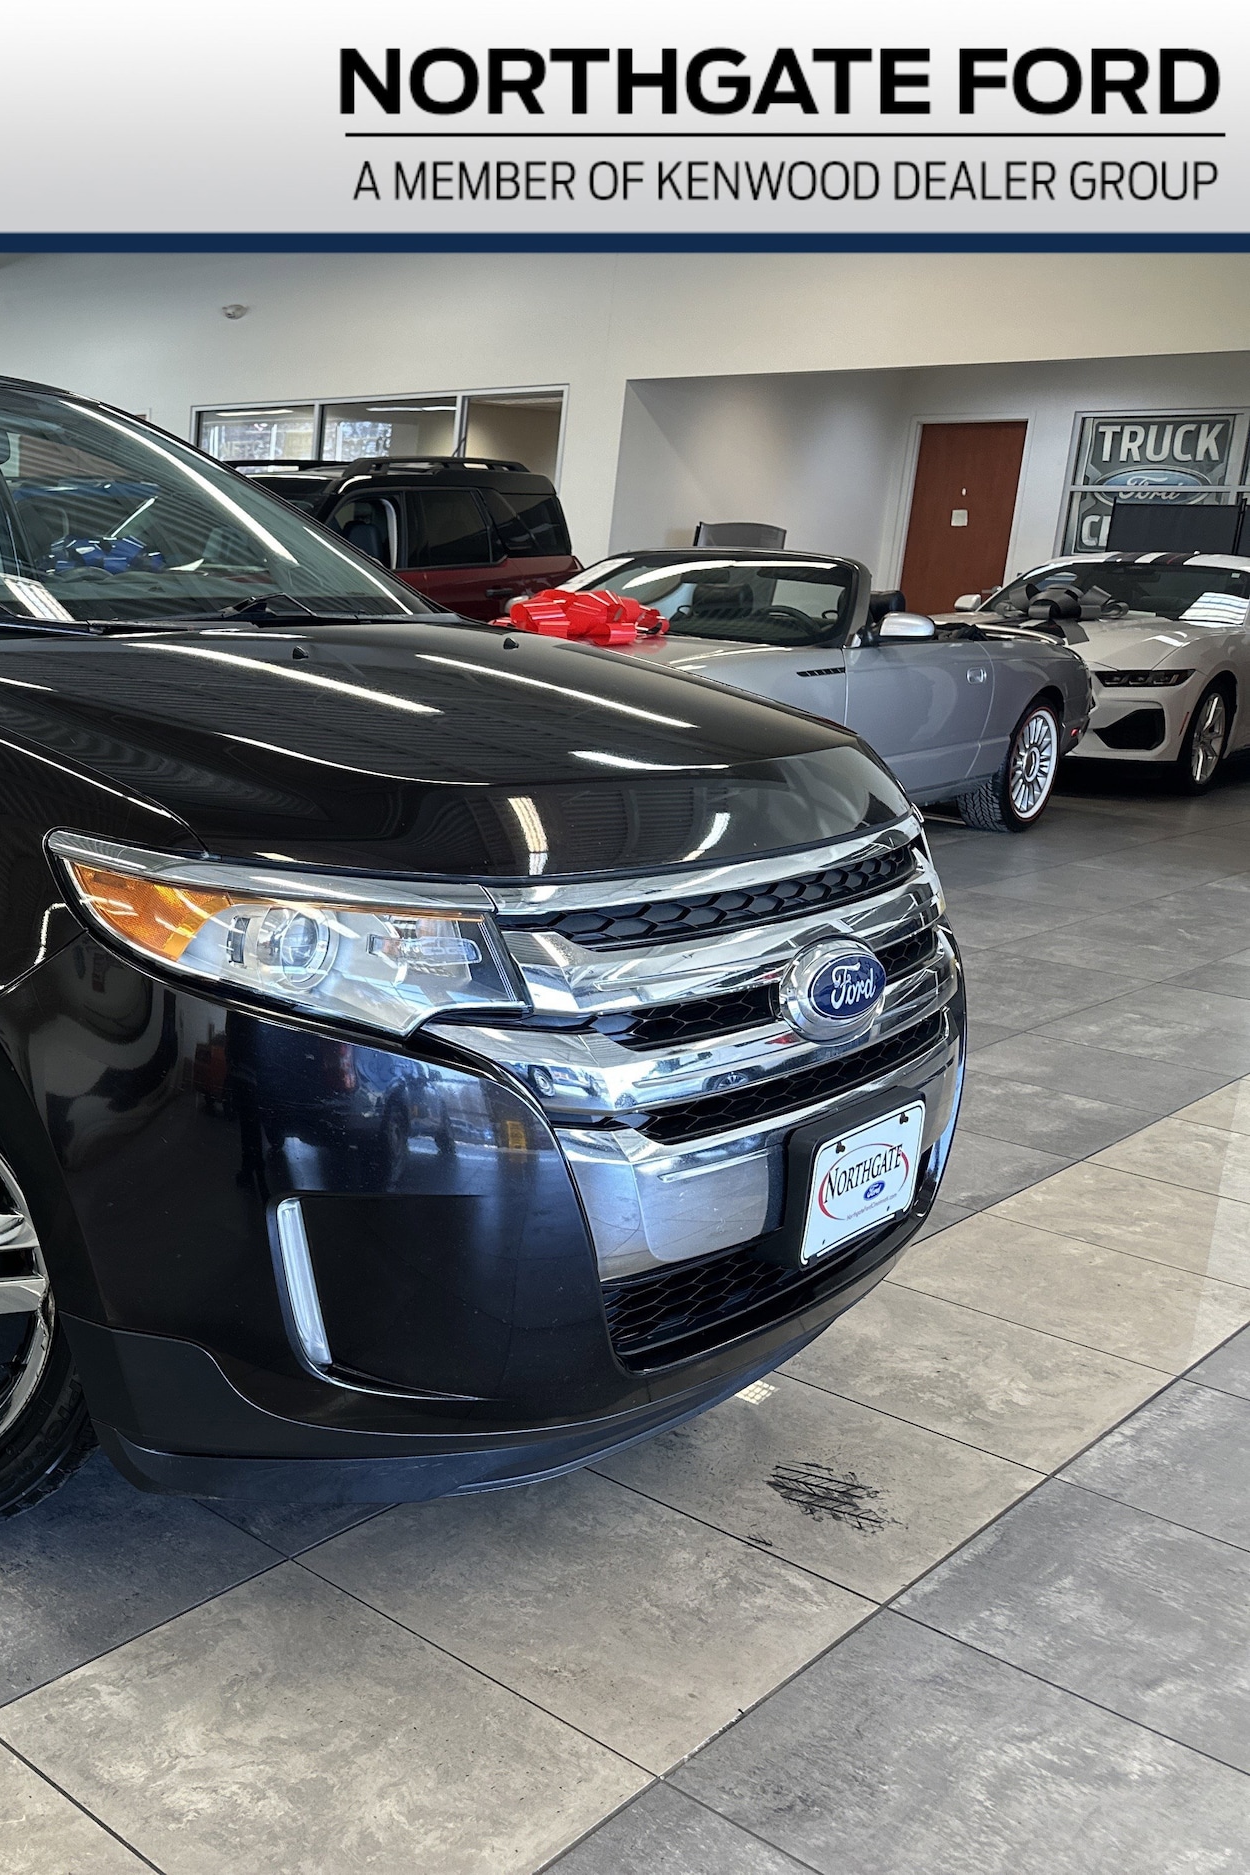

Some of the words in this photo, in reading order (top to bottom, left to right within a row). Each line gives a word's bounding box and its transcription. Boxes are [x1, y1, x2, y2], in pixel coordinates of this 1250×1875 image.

[1099, 423, 1225, 463] TRUCK
[830, 961, 876, 1010] Ford
[823, 1143, 903, 1204] NORTHGATE
